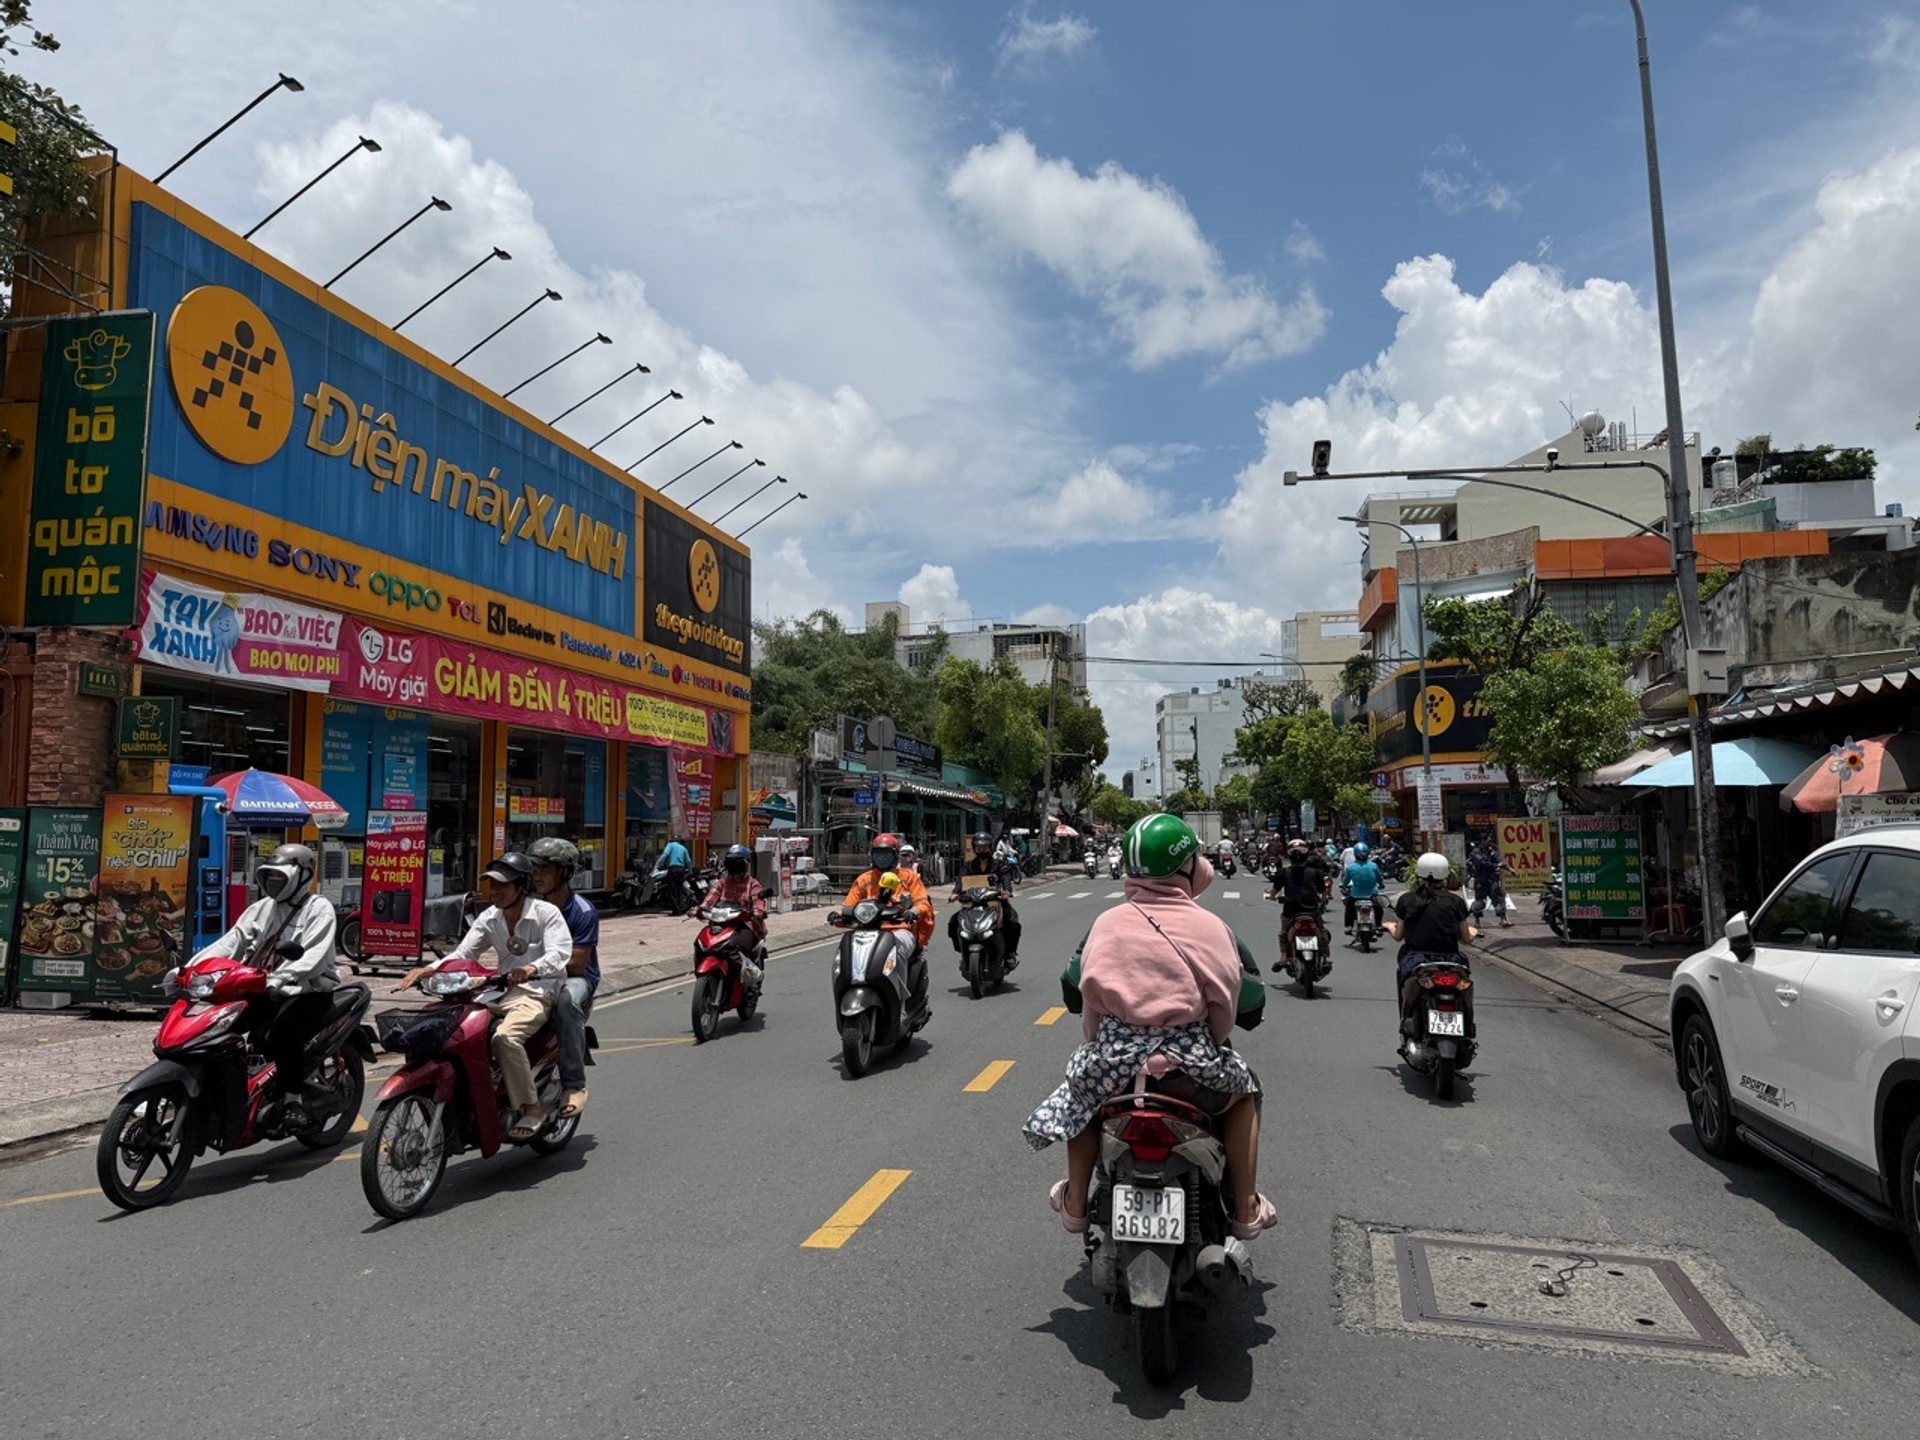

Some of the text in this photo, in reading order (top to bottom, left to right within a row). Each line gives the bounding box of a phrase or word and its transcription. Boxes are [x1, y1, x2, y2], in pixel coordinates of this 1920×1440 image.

[65, 459, 110, 495] tơ
[303, 381, 427, 494] Điện
[517, 484, 627, 581] XANH
[35, 506, 133, 556] quán
[41, 555, 121, 604] mộc
[161, 589, 220, 630] TAY
[447, 596, 482, 624] TCL
[149, 622, 217, 664] XANH
[298, 614, 336, 647] VIỆC
[656, 602, 744, 664] thegioididong
[387, 636, 413, 664] LG
[561, 630, 612, 662] Panasonic
[250, 648, 341, 676] BAO MỌI PHÍ
[359, 665, 397, 698] Máy
[434, 652, 501, 703] GIẢM
[508, 667, 554, 712] ĐẾN
[558, 679, 571, 716] 4
[574, 688, 621, 734] TRIỆU
[128, 818, 149, 829] Bia
[1503, 820, 1545, 844] CƠM
[36, 833, 100, 853] Thành Viên
[413, 840, 425, 850] LG
[1168, 835, 1191, 856] Grab
[46, 858, 84, 883] 15%
[366, 852, 424, 868] GIẢM ĐẾN
[1504, 846, 1548, 870] TẤM
[371, 868, 414, 886] 4 TRIỆU
[1124, 1190, 1171, 1214] 59-P1
[1117, 1214, 1180, 1240] 369.82
